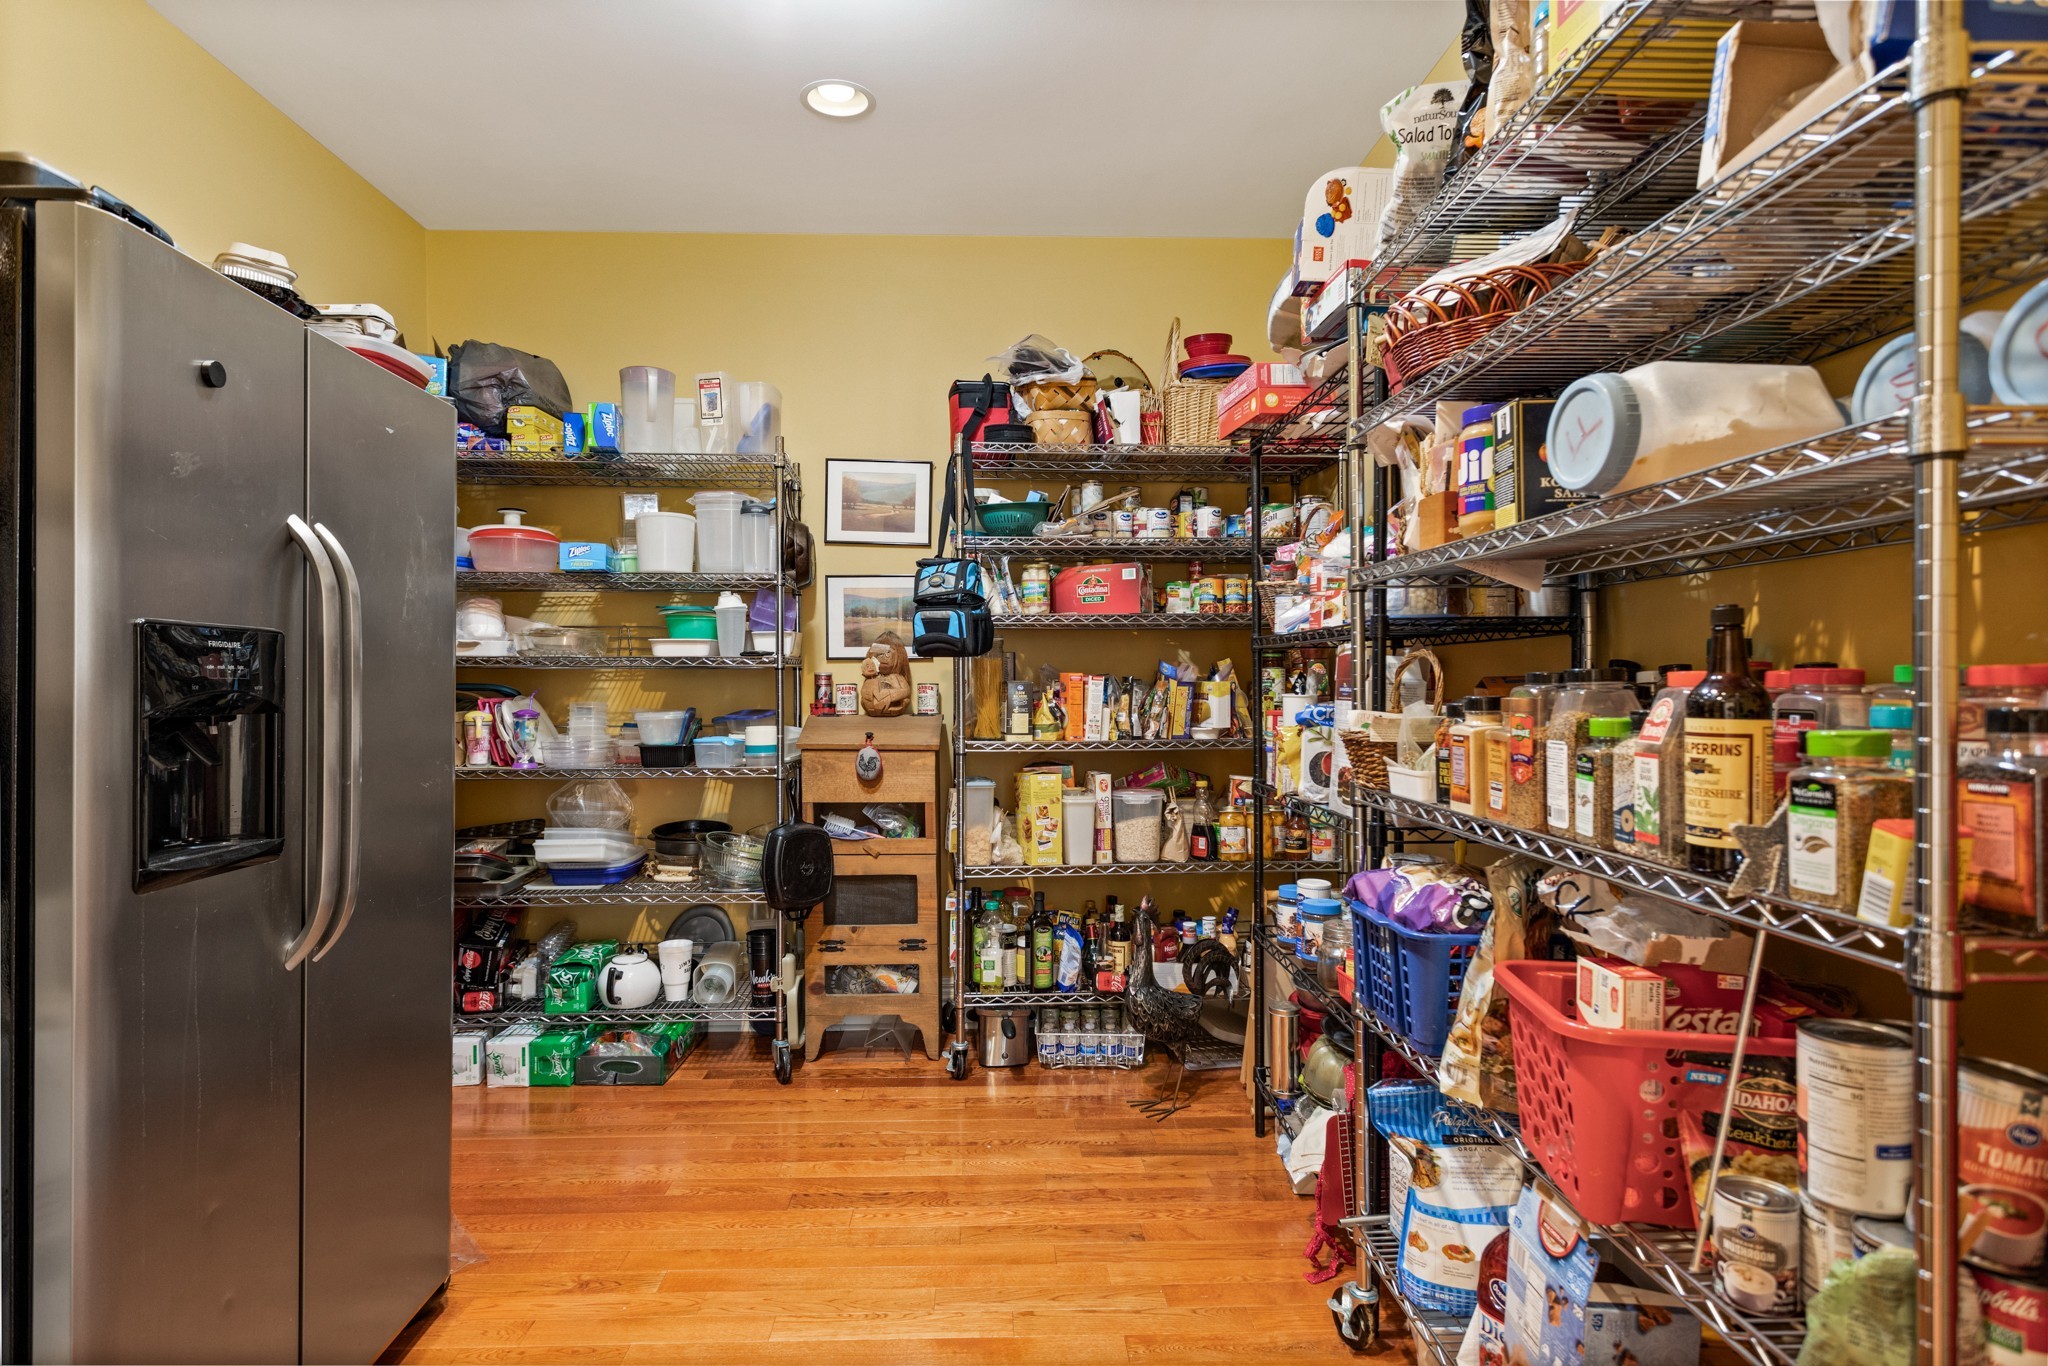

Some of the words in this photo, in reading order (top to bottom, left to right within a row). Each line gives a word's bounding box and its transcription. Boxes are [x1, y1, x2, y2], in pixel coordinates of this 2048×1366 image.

[1398, 126, 1434, 144] Salad
[601, 412, 614, 437] Ziploc
[564, 422, 576, 447] Ziploc
[569, 545, 591, 558] Ziploc
[1078, 586, 1108, 595] Contadina
[208, 640, 241, 649] FRIGIDAIRE
[1691, 742, 1742, 757] PERRINS
[1792, 787, 1834, 800] McCormick
[1689, 1072, 1723, 1084] NEW!
[1433, 1110, 1472, 1132] Pretzel
[1453, 1136, 1495, 1144] ORIGINAL
[1722, 1237, 1777, 1263] MUSHROOM
